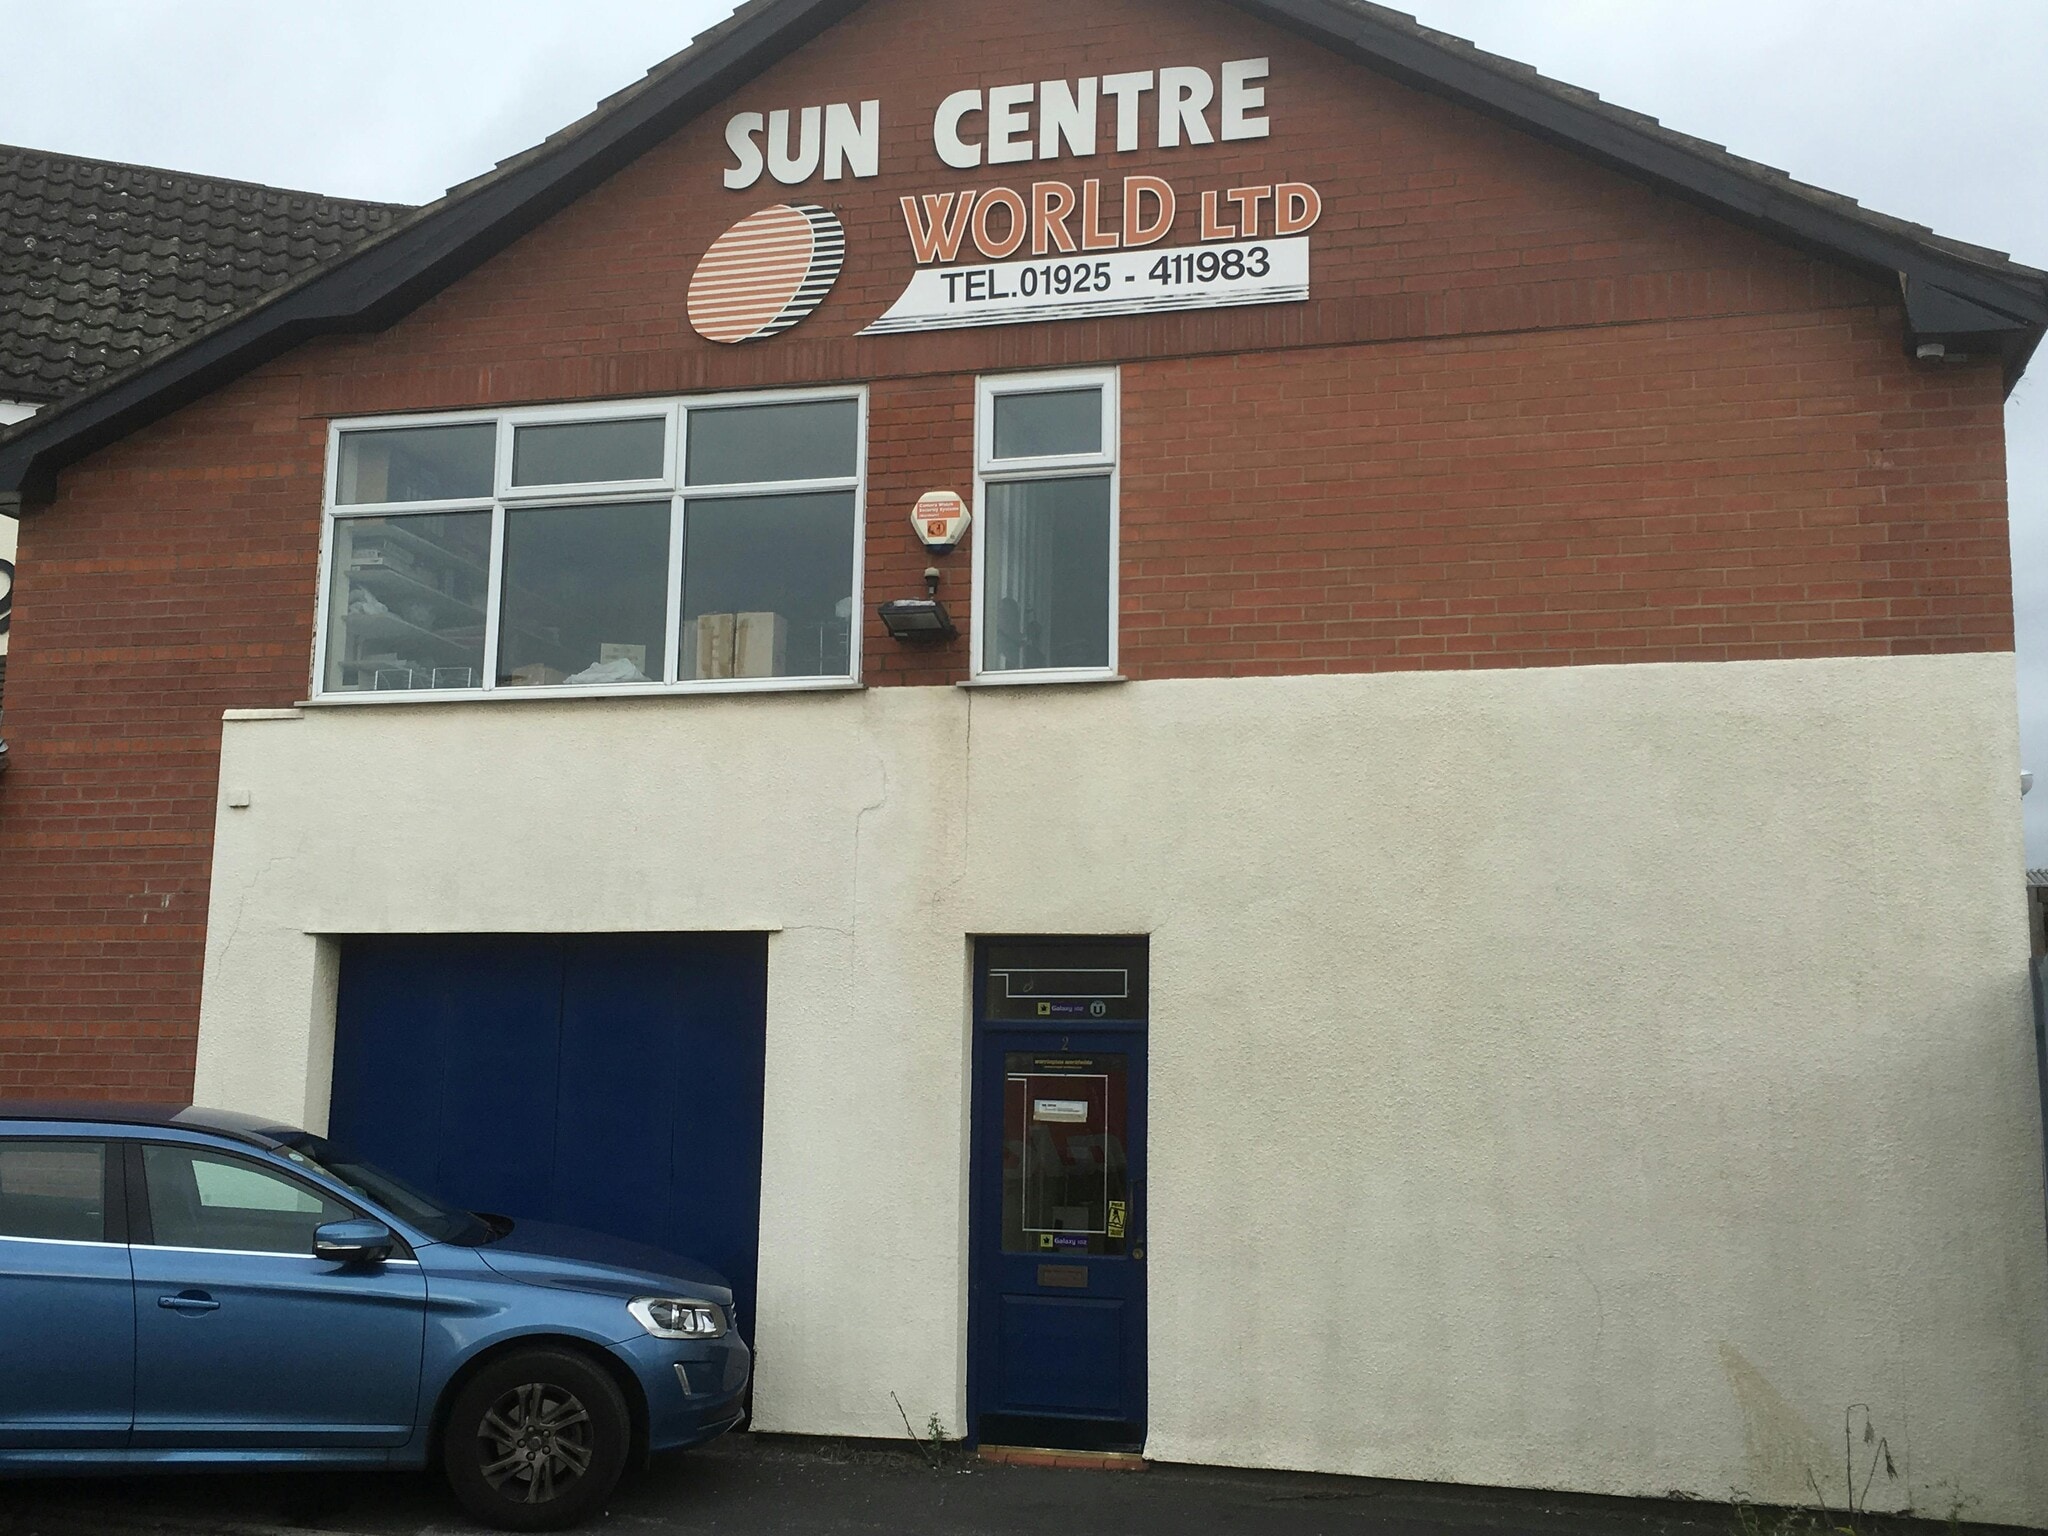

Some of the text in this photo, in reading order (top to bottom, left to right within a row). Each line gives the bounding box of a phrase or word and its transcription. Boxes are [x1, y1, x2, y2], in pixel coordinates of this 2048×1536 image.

[723, 56, 1270, 190] SUN CENTRE
[900, 175, 1322, 265] WORLD LTD
[1148, 246, 1271, 287] 411983
[1061, 1036, 1069, 1051] 2
[1054, 1237, 1076, 1246] Galaxy
